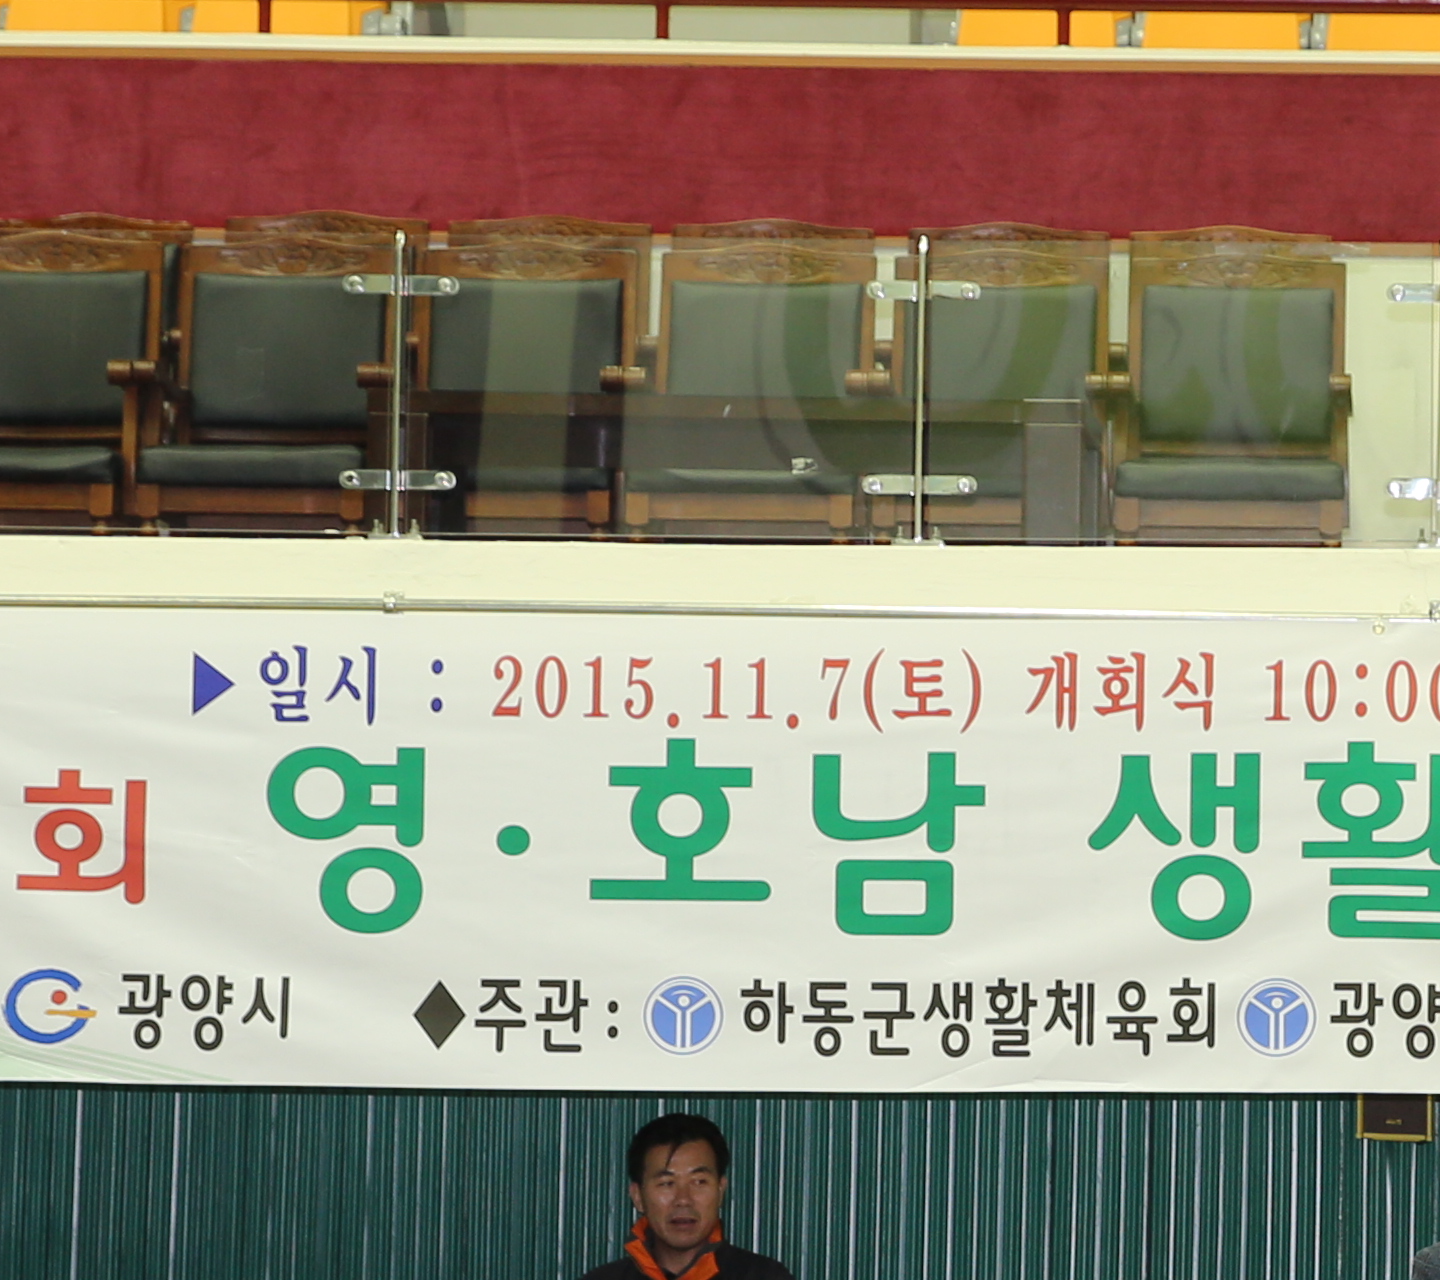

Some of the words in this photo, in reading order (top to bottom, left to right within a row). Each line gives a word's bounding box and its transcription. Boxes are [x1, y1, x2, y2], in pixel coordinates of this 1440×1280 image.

[259, 645, 377, 726] 일시
[491, 649, 982, 733] 2015.11.7(토)
[1025, 652, 1215, 732] 개회식
[118, 973, 291, 1050] 광양시
[740, 978, 1216, 1058] 하동군생활체육회
